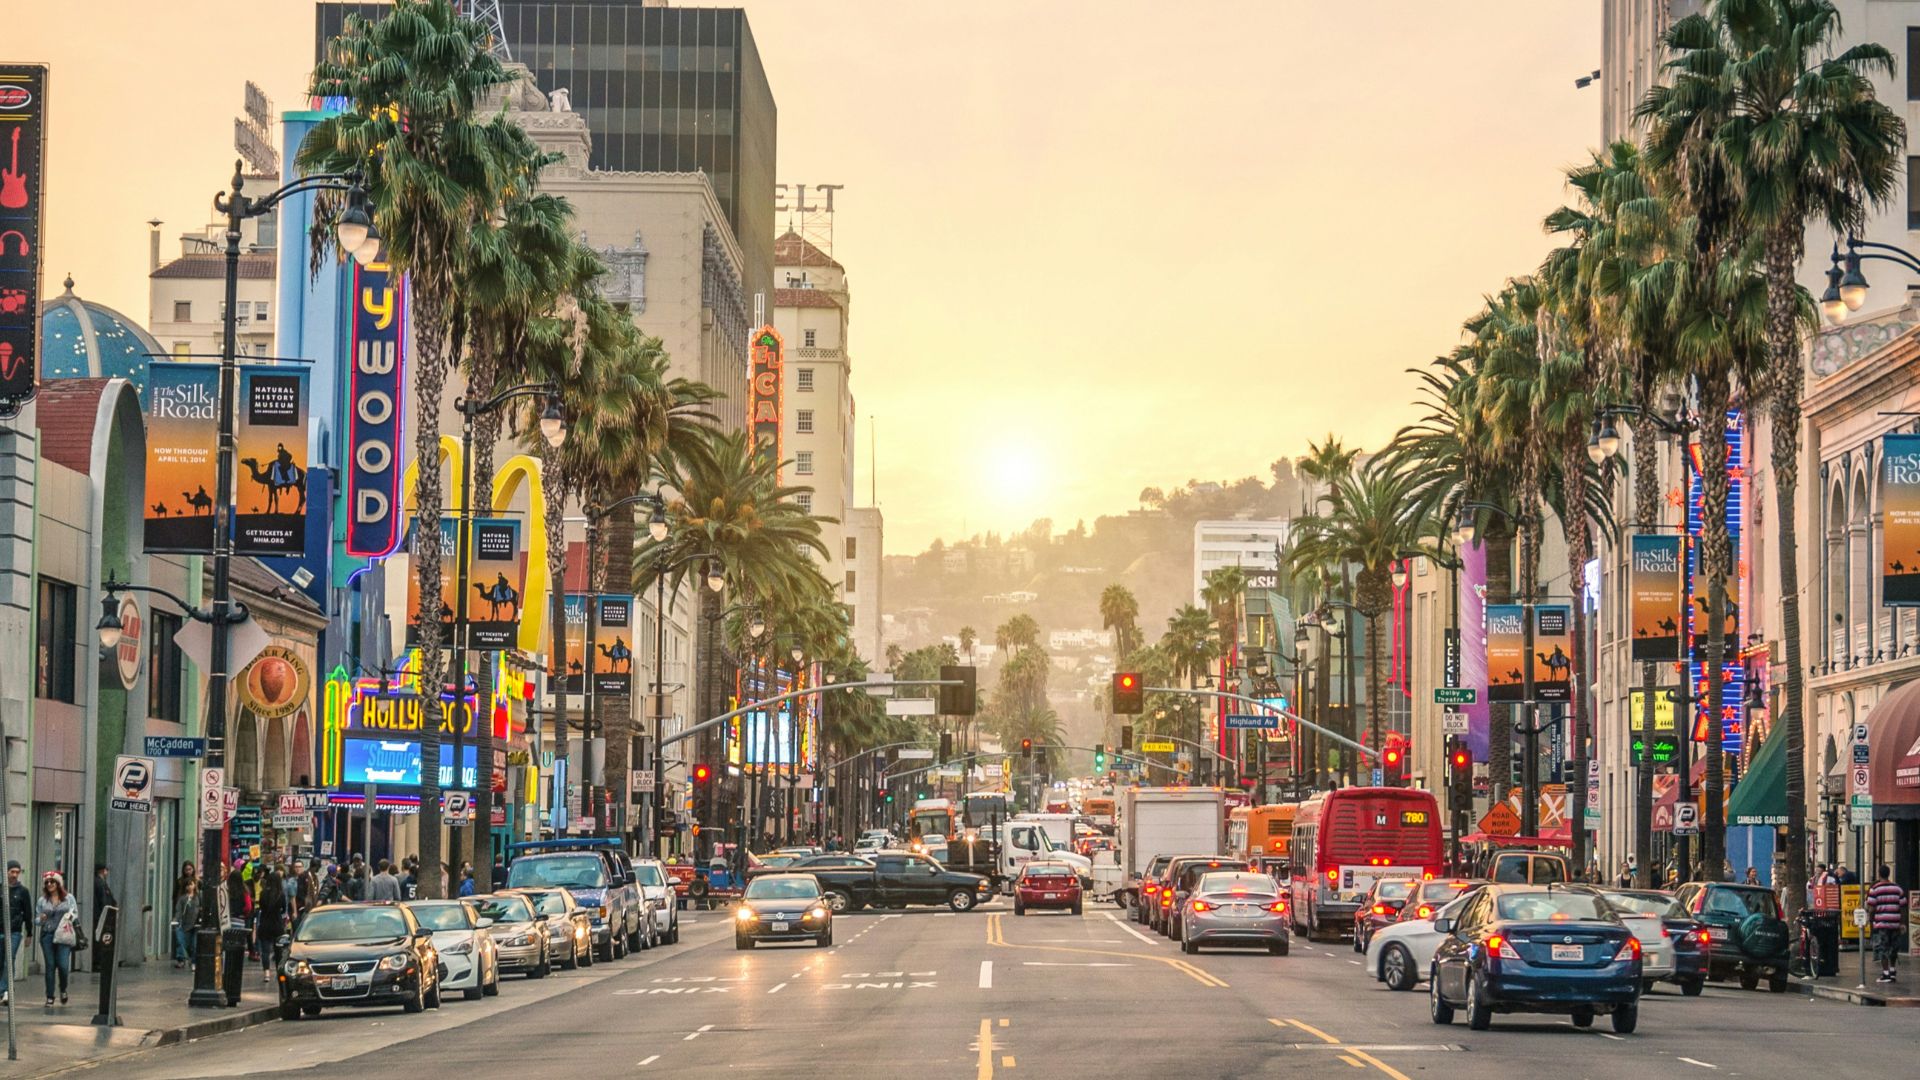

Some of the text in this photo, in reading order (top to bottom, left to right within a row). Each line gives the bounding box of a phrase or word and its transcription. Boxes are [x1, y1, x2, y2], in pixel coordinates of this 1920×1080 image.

[754, 345, 779, 370] EL
[160, 384, 210, 404] The Silk
[255, 386, 294, 394] NATURAL
[160, 397, 215, 419] Road
[254, 401, 294, 409] MUSEUM
[154, 447, 209, 456] NOW THROUGH
[1894, 456, 1907, 464] The
[1650, 548, 1673, 562] Silk
[1640, 557, 1677, 572] Road
[565, 614, 584, 624] oad
[1500, 616, 1519, 626] Silk
[1492, 622, 1522, 634] Road
[282, 650, 304, 674] KING
[248, 700, 295, 716] Since 1989
[1230, 718, 1262, 726] Highland
[147, 738, 194, 749] McCadden
[114, 801, 148, 811] PAY HERE
[281, 795, 304, 808] ATM
[1406, 812, 1424, 823] 780
[1737, 815, 1762, 824] CAMERAS
[1353, 870, 1385, 878] Unlimited
[409, 887, 416, 898] 5
